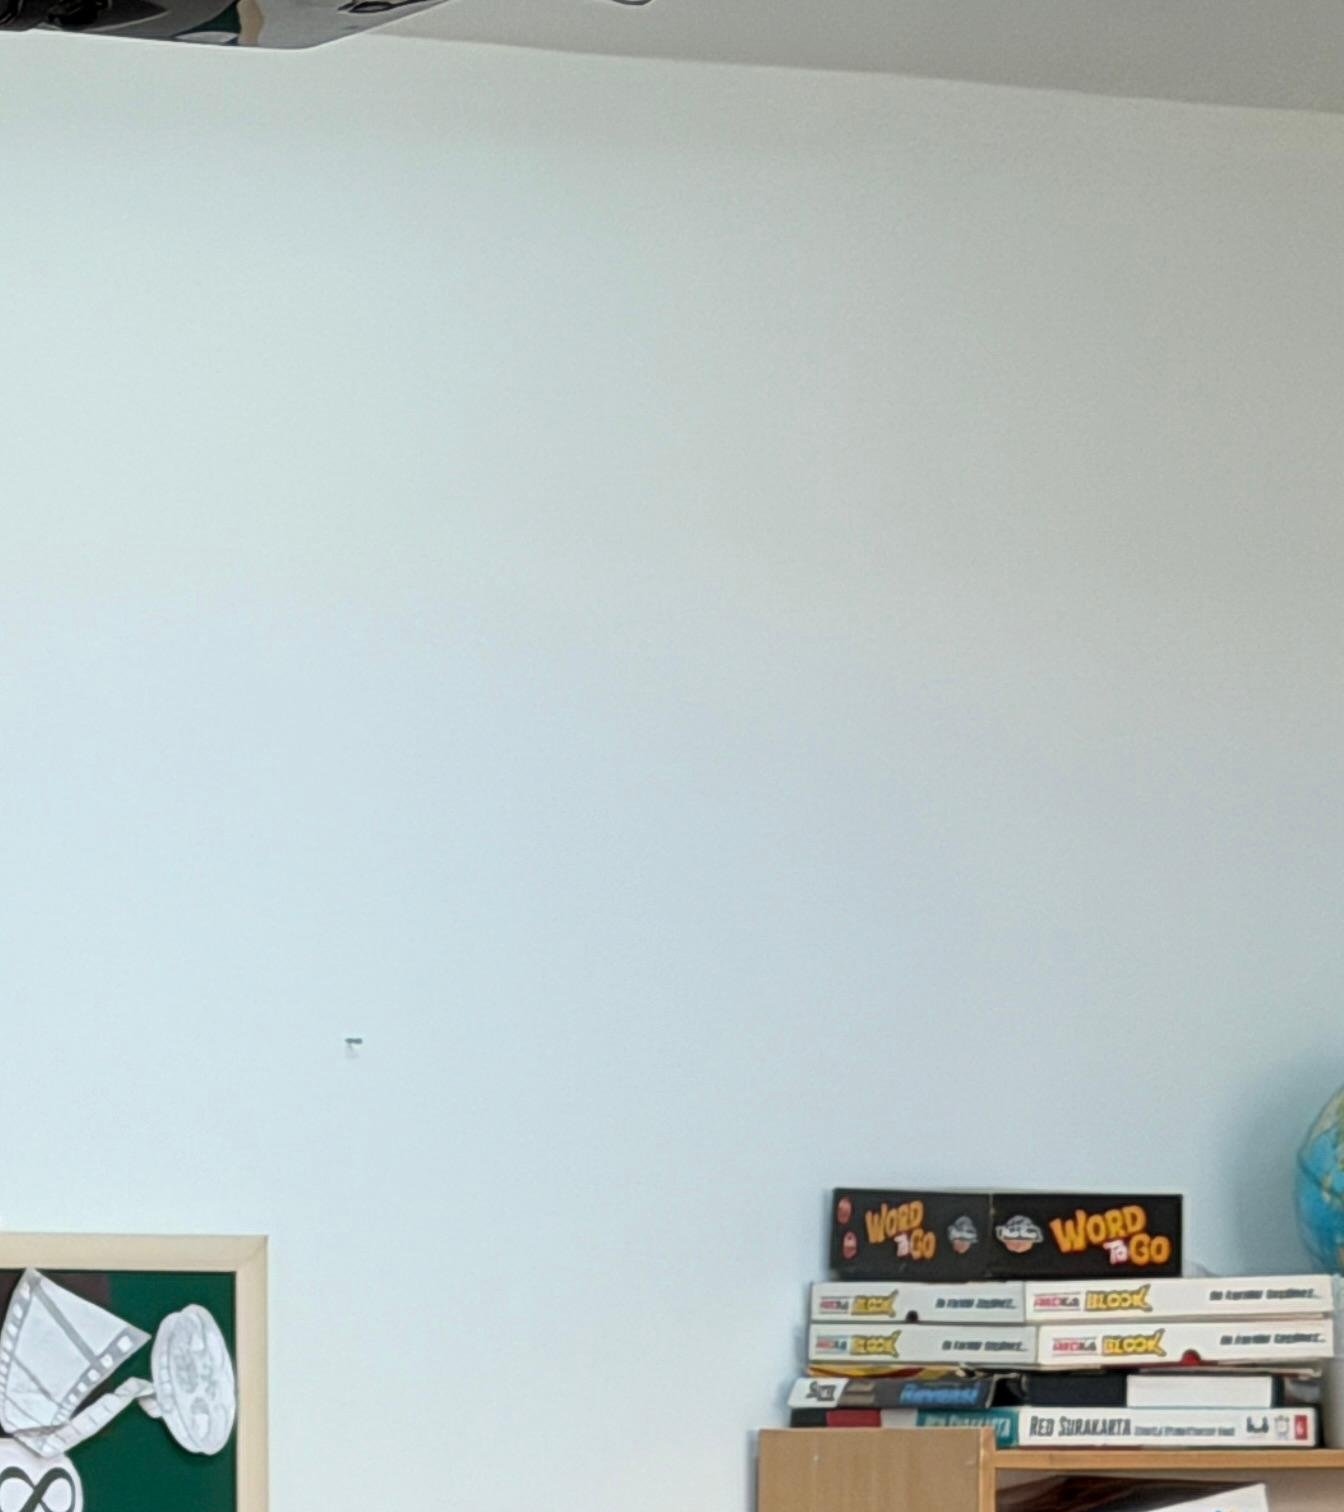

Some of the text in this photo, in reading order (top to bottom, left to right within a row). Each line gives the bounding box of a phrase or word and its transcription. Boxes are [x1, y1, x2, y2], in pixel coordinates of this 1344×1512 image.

[865, 1200, 924, 1244] WORD
[1049, 1204, 1147, 1254] WORD
[1129, 1233, 1171, 1265] GO
